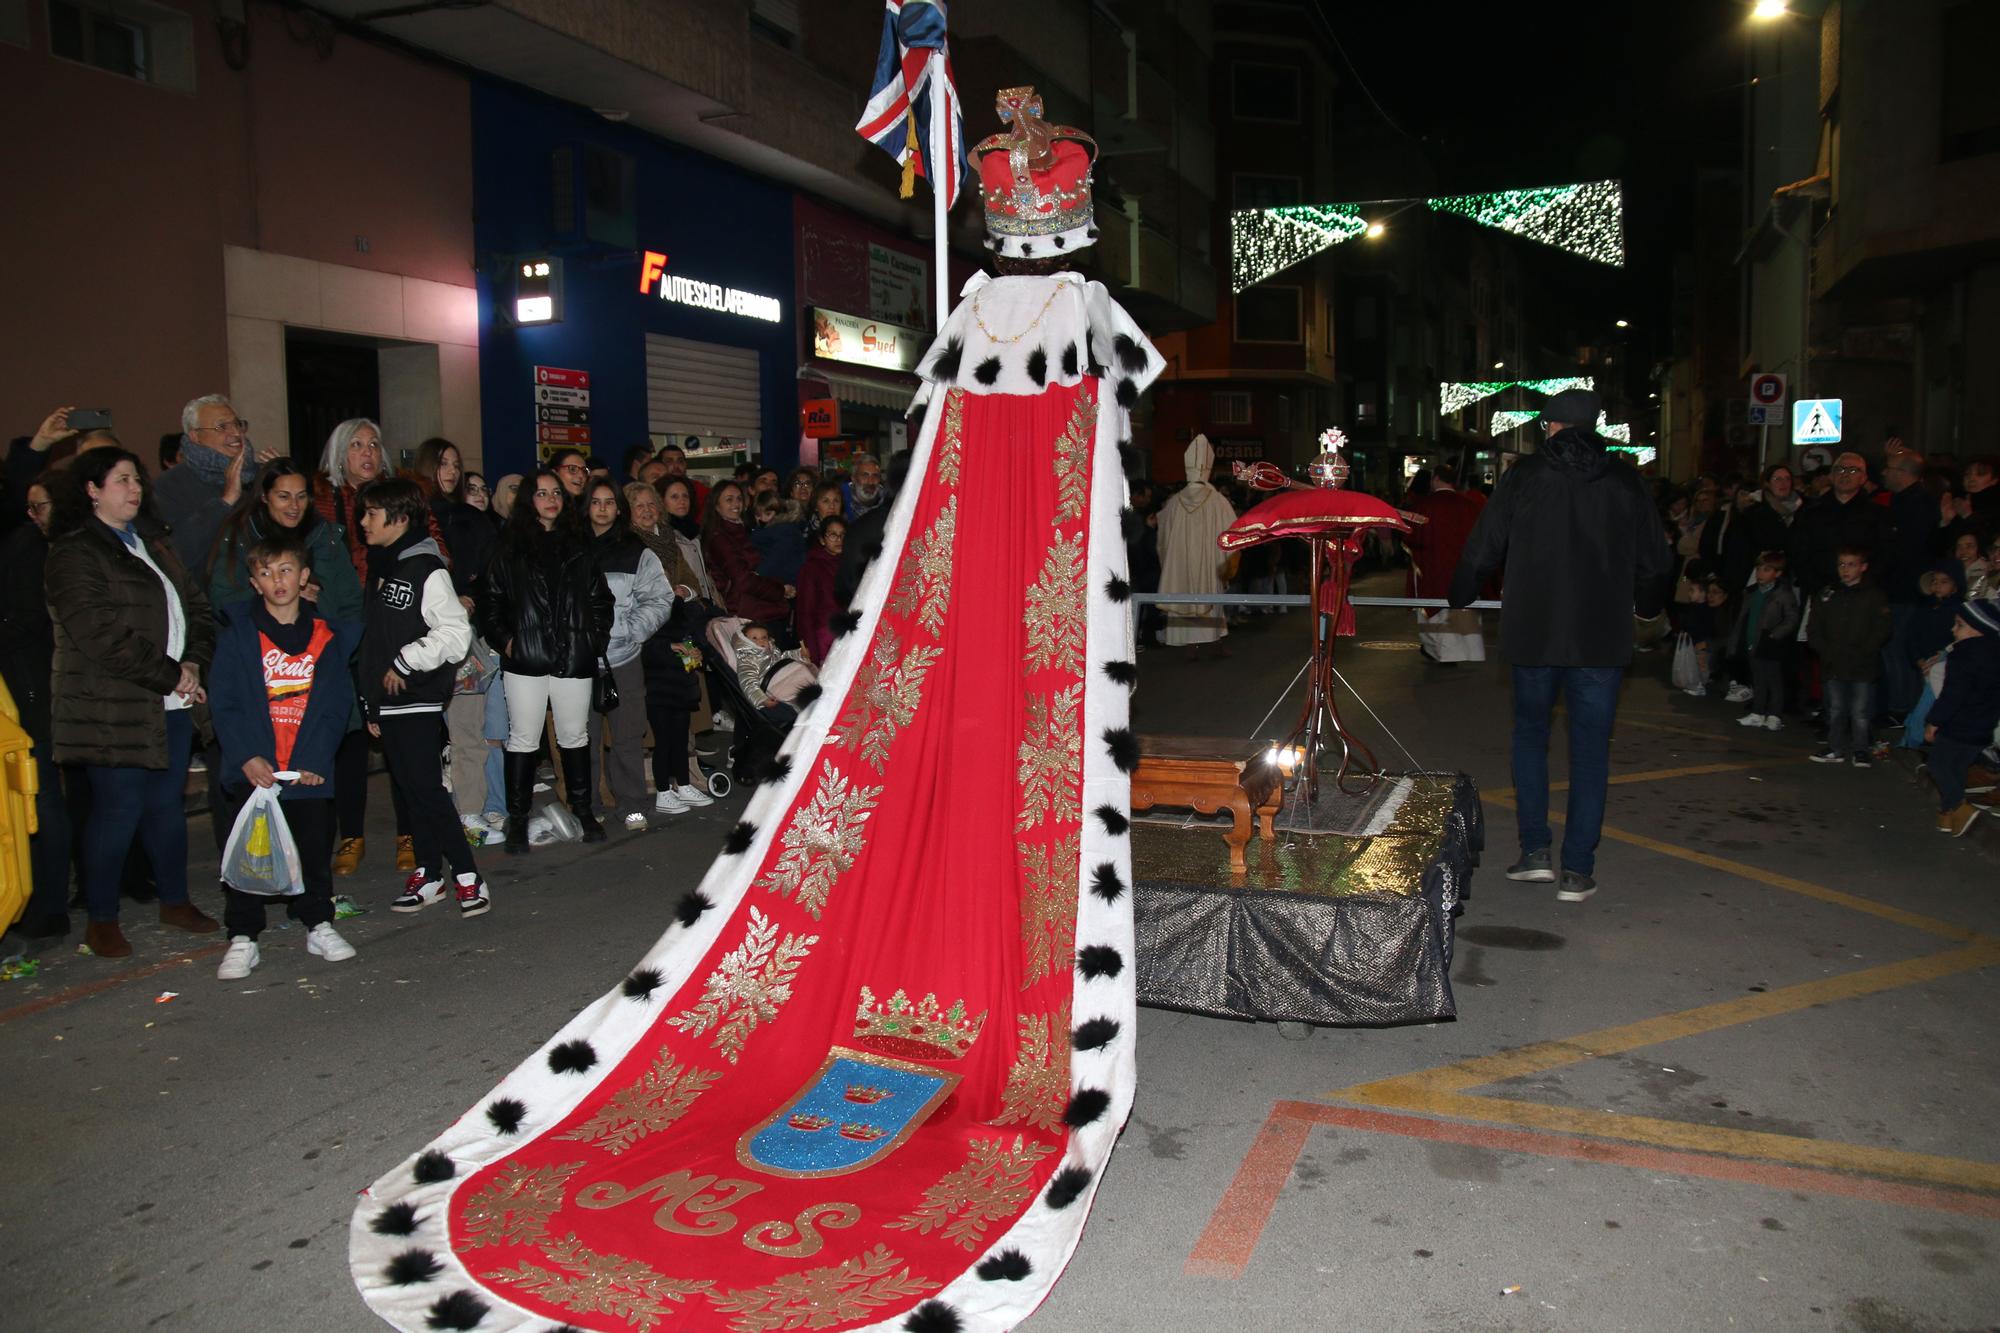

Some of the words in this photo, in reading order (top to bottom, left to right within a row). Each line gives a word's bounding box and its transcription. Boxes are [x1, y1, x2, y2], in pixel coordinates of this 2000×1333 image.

[640, 250, 668, 295] F
[861, 324, 897, 354] Syed
[807, 407, 833, 423] Ria
[263, 648, 315, 684] Skate
